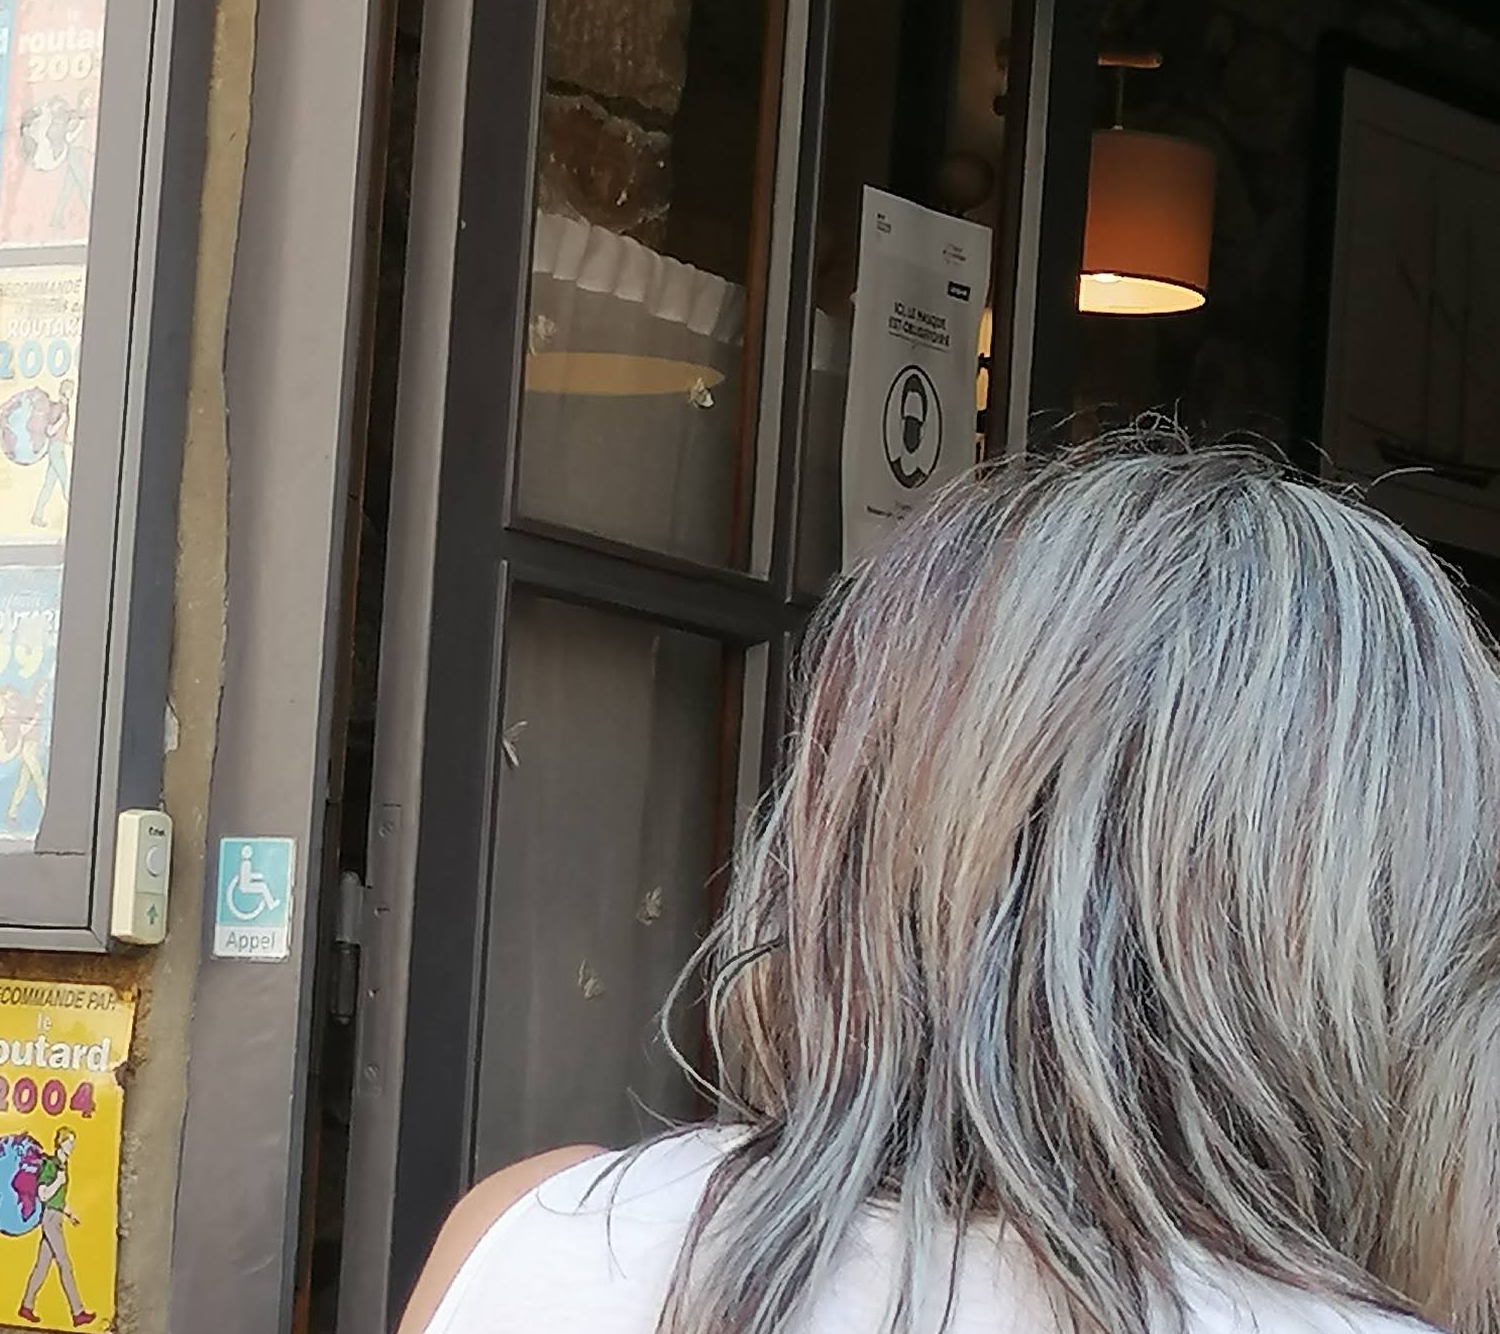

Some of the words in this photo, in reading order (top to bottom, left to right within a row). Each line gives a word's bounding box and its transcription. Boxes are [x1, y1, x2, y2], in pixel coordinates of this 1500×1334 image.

[27, 53, 99, 84] 200
[225, 931, 276, 954] Appel
[36, 1013, 53, 1032] le
